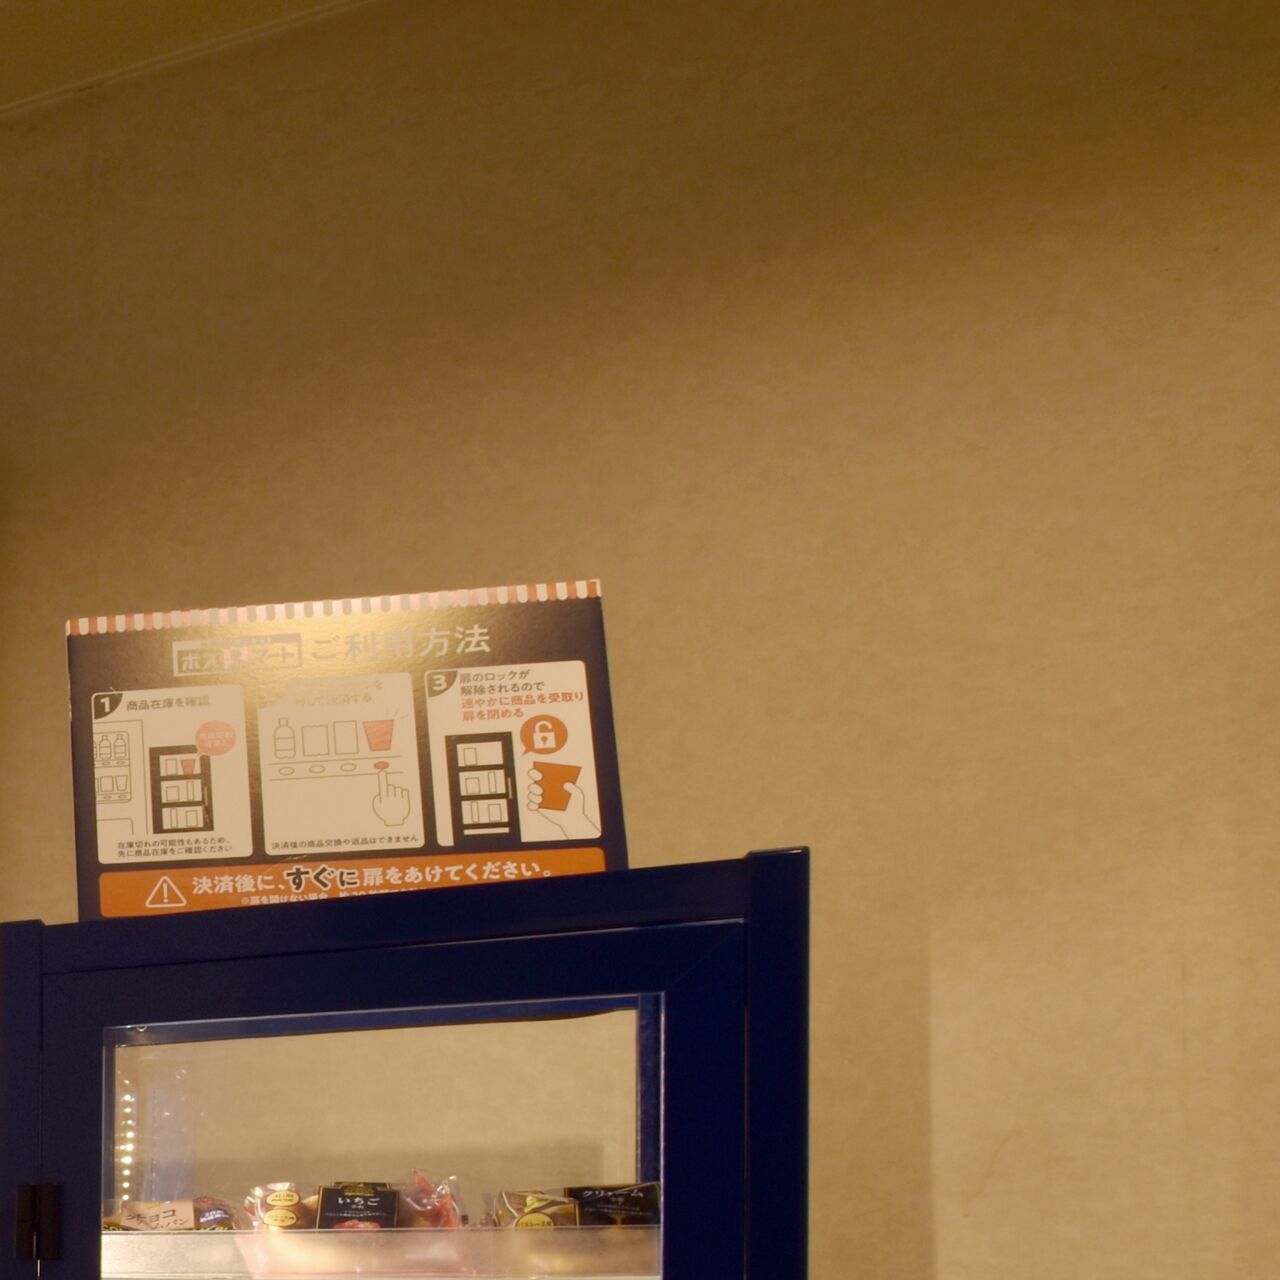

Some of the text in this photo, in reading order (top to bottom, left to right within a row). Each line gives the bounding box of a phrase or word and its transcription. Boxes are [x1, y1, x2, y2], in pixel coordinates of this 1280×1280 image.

[433, 675, 447, 690] 3
[460, 669, 530, 684] 扉のロックが
[461, 682, 544, 696] 解除されるので
[100, 697, 110, 712] 1
[127, 696, 210, 711] 商品在庫を確認
[461, 691, 583, 709] 速やかに商品を受取り
[462, 708, 524, 721] 扉を閉める
[117, 838, 230, 850] 在庫切れの可能性もあるため、
[271, 834, 419, 850] 決済後の商品交換や返品はできません
[117, 845, 232, 858] 先に商品在庫をご確認ください
[336, 1194, 381, 1208] いちご
